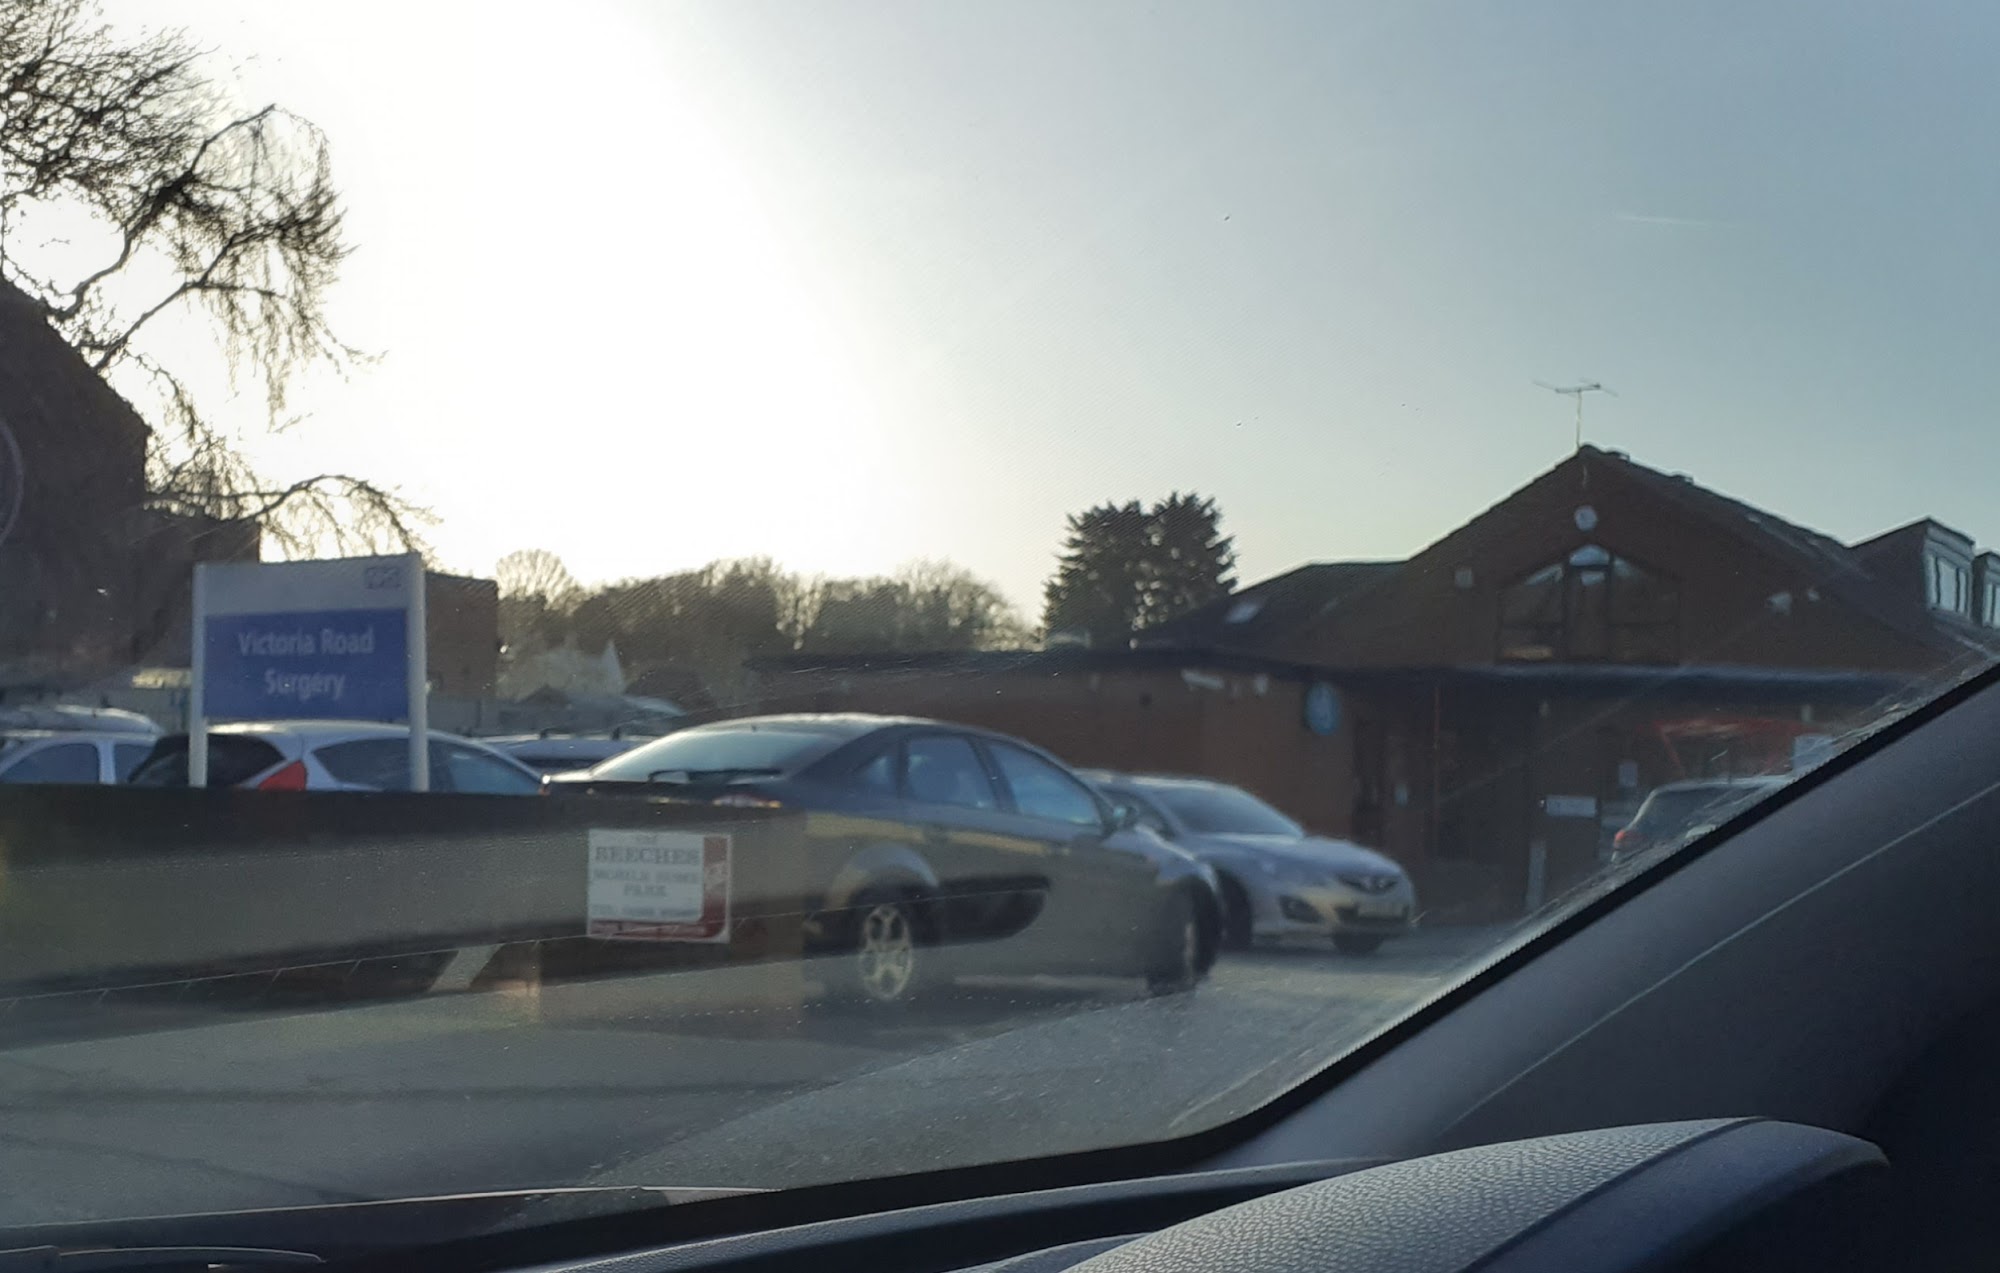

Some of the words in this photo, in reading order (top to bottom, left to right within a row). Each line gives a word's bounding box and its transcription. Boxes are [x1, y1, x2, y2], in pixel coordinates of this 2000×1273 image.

[238, 628, 315, 656] Victoria
[321, 627, 374, 654] Road
[264, 669, 345, 701] Surgery
[595, 846, 700, 866] BEECHES
